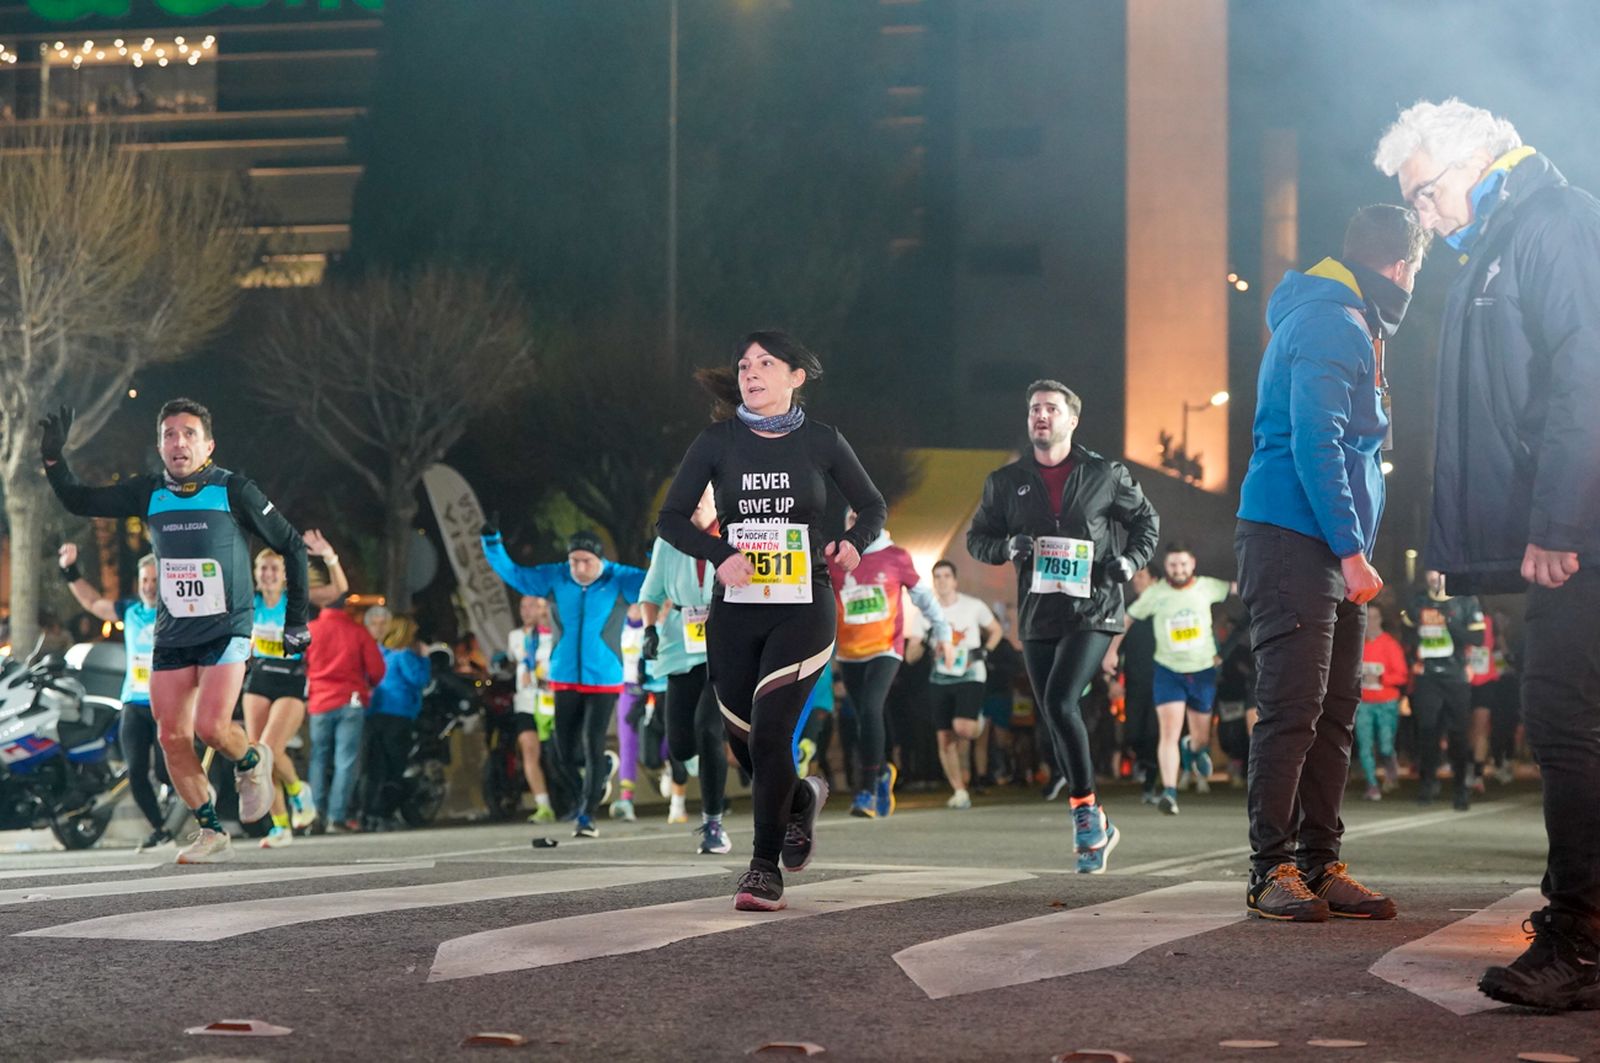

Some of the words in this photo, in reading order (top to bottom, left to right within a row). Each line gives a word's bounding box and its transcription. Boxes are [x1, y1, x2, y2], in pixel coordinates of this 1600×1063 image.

[742, 472, 790, 491] NEVER
[738, 498, 771, 515] GIVE
[775, 497, 795, 514] UP
[162, 523, 183, 532] MEDIA
[184, 521, 208, 530] LEGUA
[744, 532, 768, 540] NOCHE
[769, 532, 779, 540] DE
[736, 541, 750, 551] SAN
[751, 540, 779, 551] ANTÓN
[1044, 557, 1078, 577] 7891
[176, 580, 204, 597] 370
